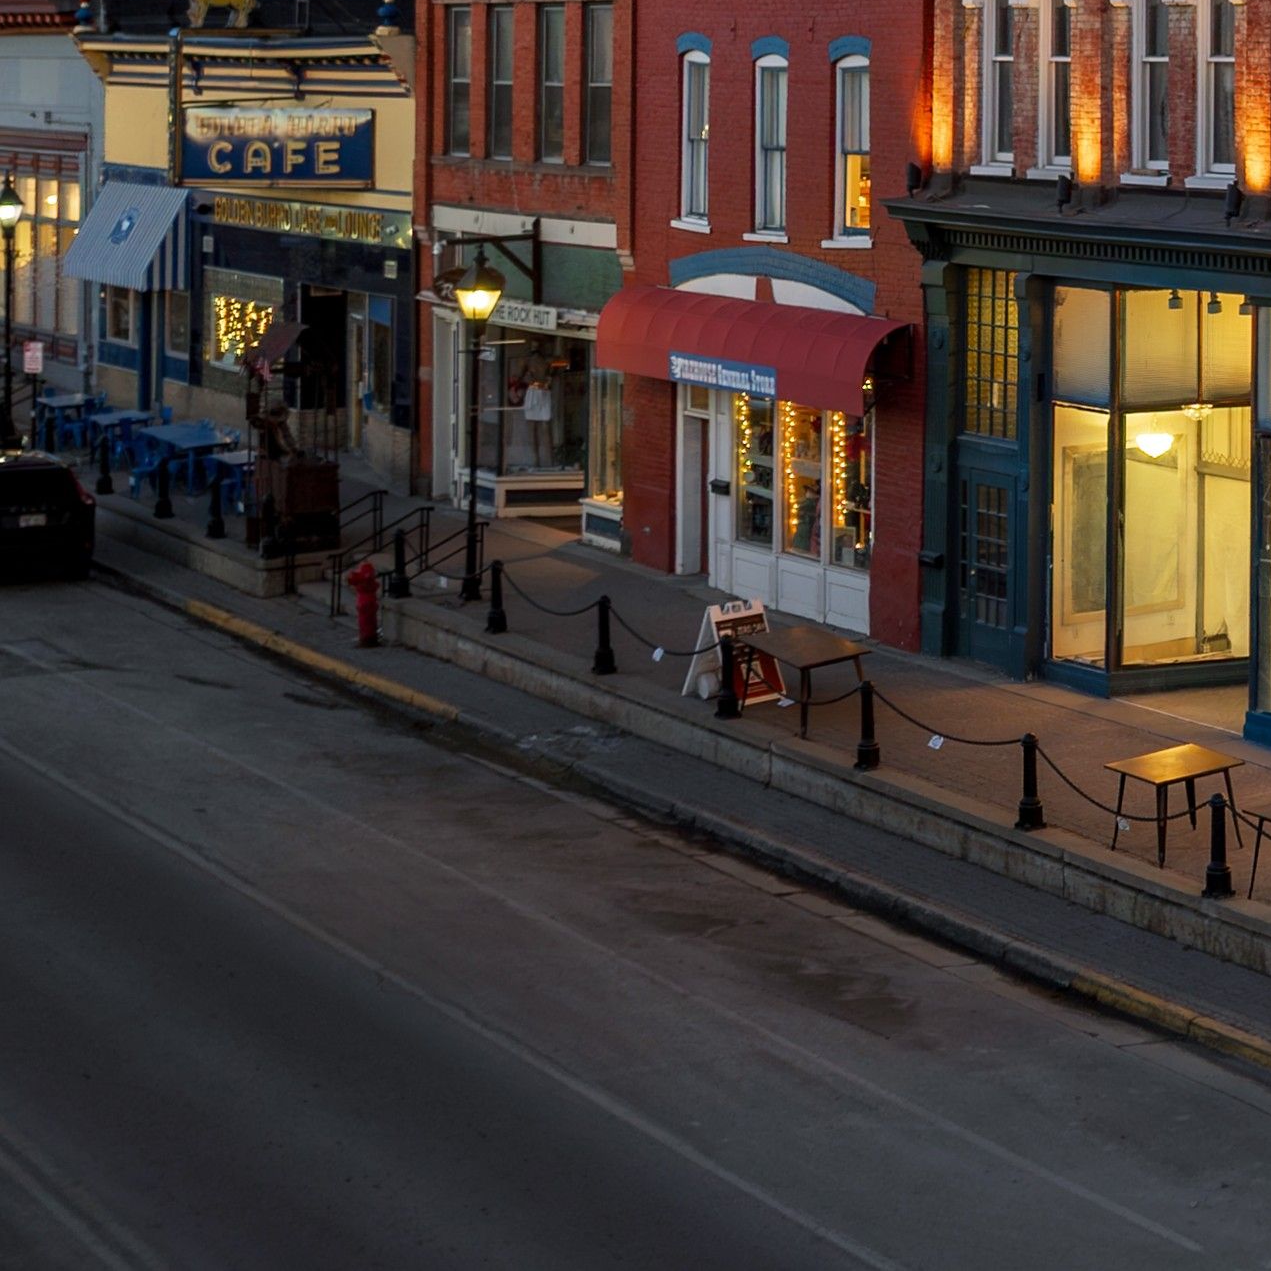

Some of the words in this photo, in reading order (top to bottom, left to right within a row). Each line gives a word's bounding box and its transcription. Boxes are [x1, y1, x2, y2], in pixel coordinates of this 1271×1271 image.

[207, 140, 341, 174] CAFE
[508, 306, 530, 322] ROCK
[534, 310, 550, 326] HUT
